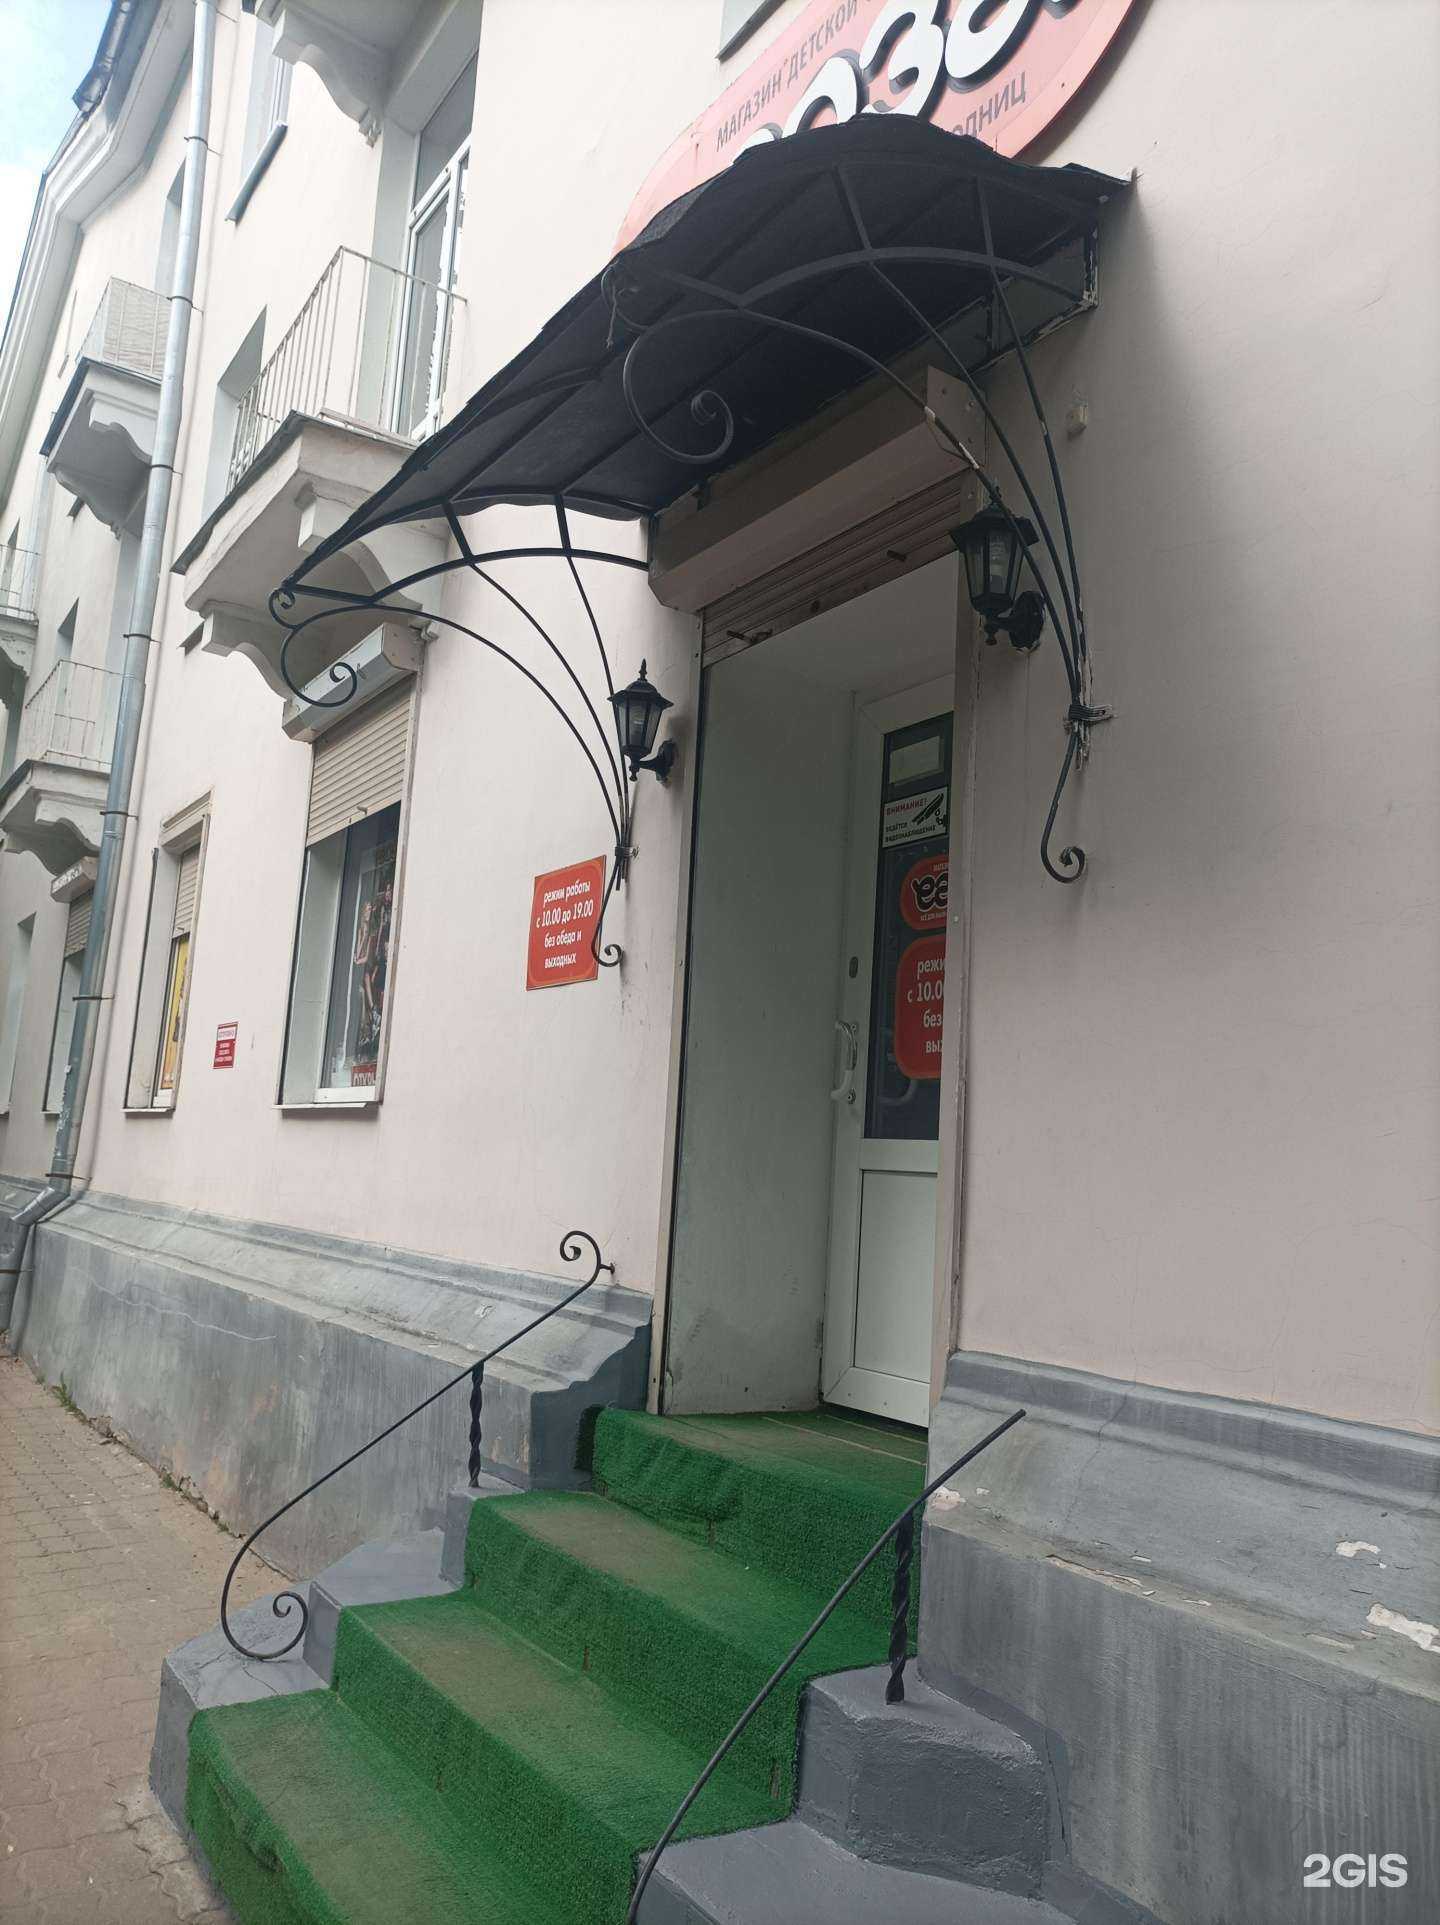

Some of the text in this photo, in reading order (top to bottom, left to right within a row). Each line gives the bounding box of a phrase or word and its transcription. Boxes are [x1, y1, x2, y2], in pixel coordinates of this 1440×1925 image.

[716, 69, 783, 152] МАГАЗИН
[543, 880, 591, 907] режим работы
[541, 907, 561, 927] 10.00
[561, 911, 571, 925] до
[573, 899, 594, 920] 19.00
[544, 934, 556, 949] без
[544, 953, 577, 969] выходных
